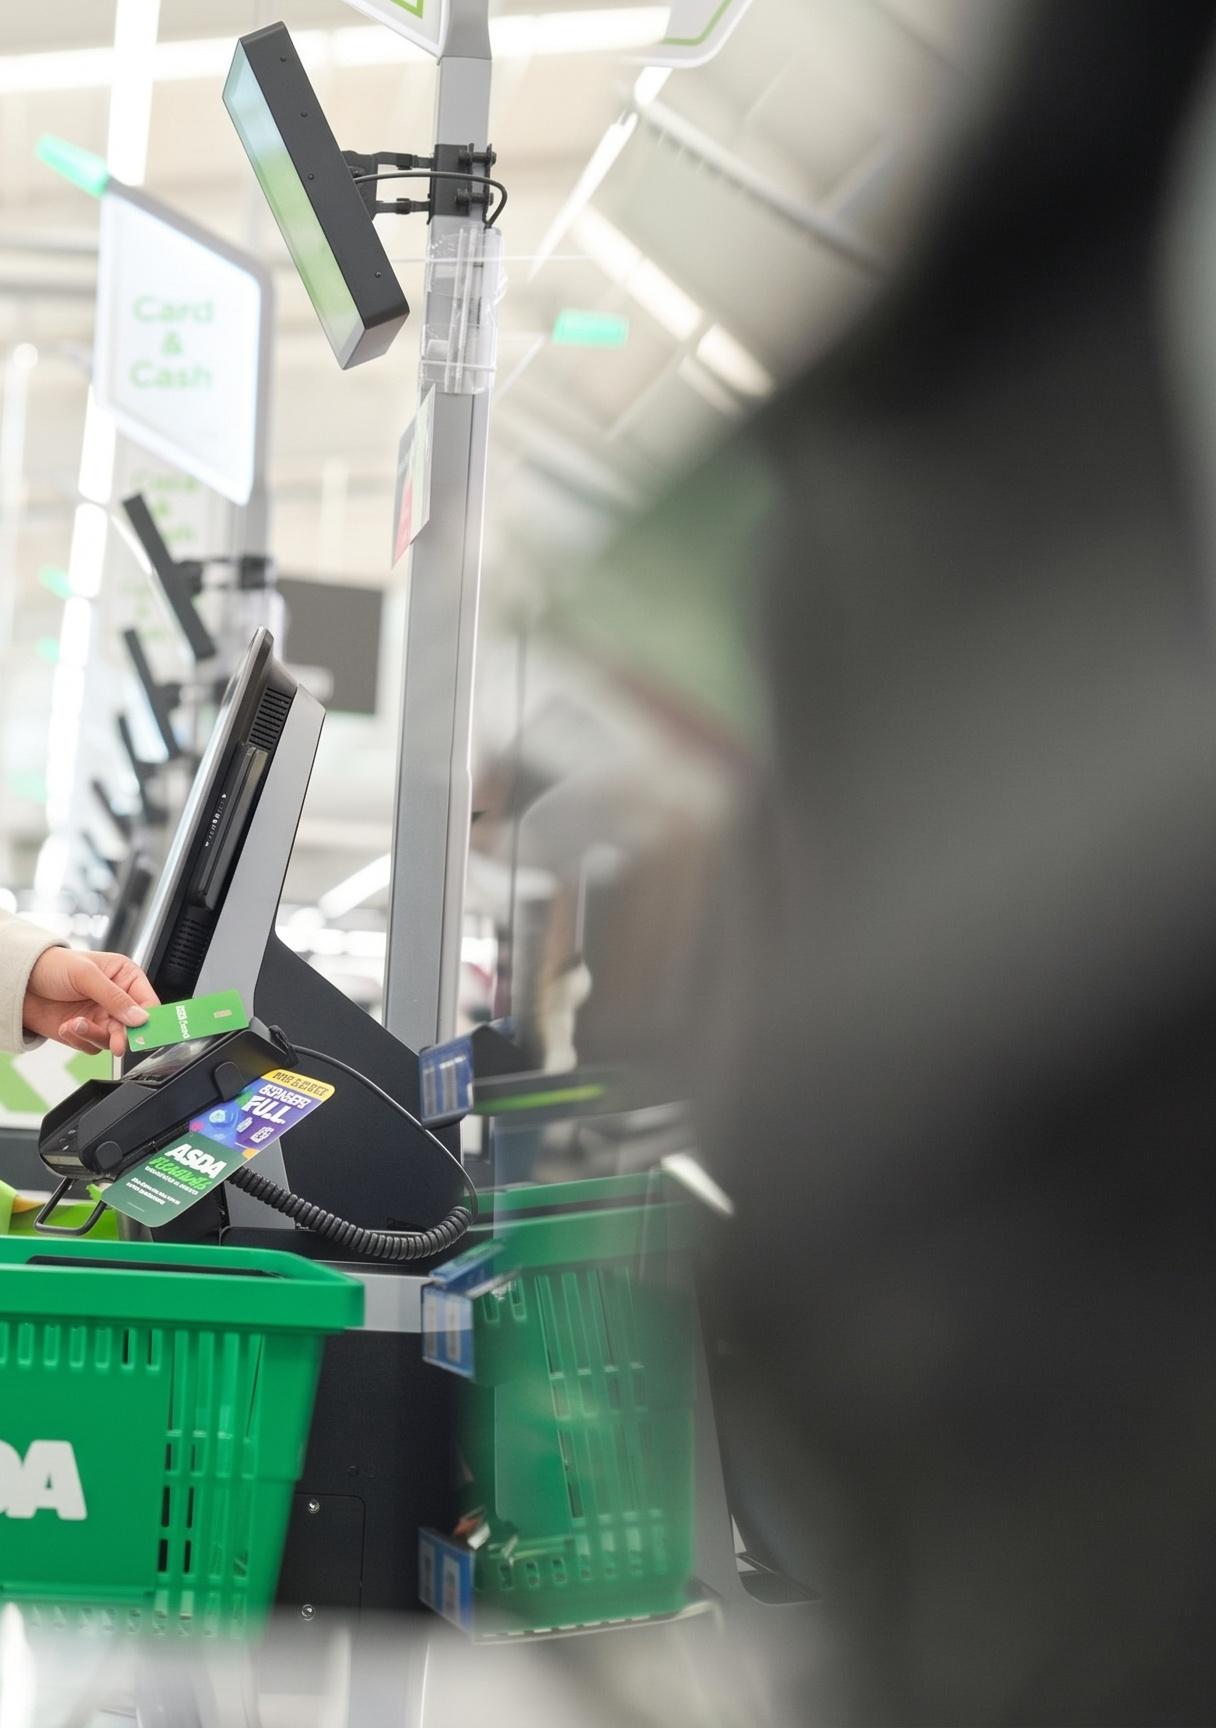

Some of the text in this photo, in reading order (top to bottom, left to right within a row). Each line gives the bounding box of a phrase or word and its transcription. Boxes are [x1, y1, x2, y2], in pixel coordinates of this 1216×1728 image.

[131, 294, 215, 324] Card
[161, 331, 184, 356] &
[129, 359, 215, 390] Cash
[164, 1143, 228, 1179] ASDA
